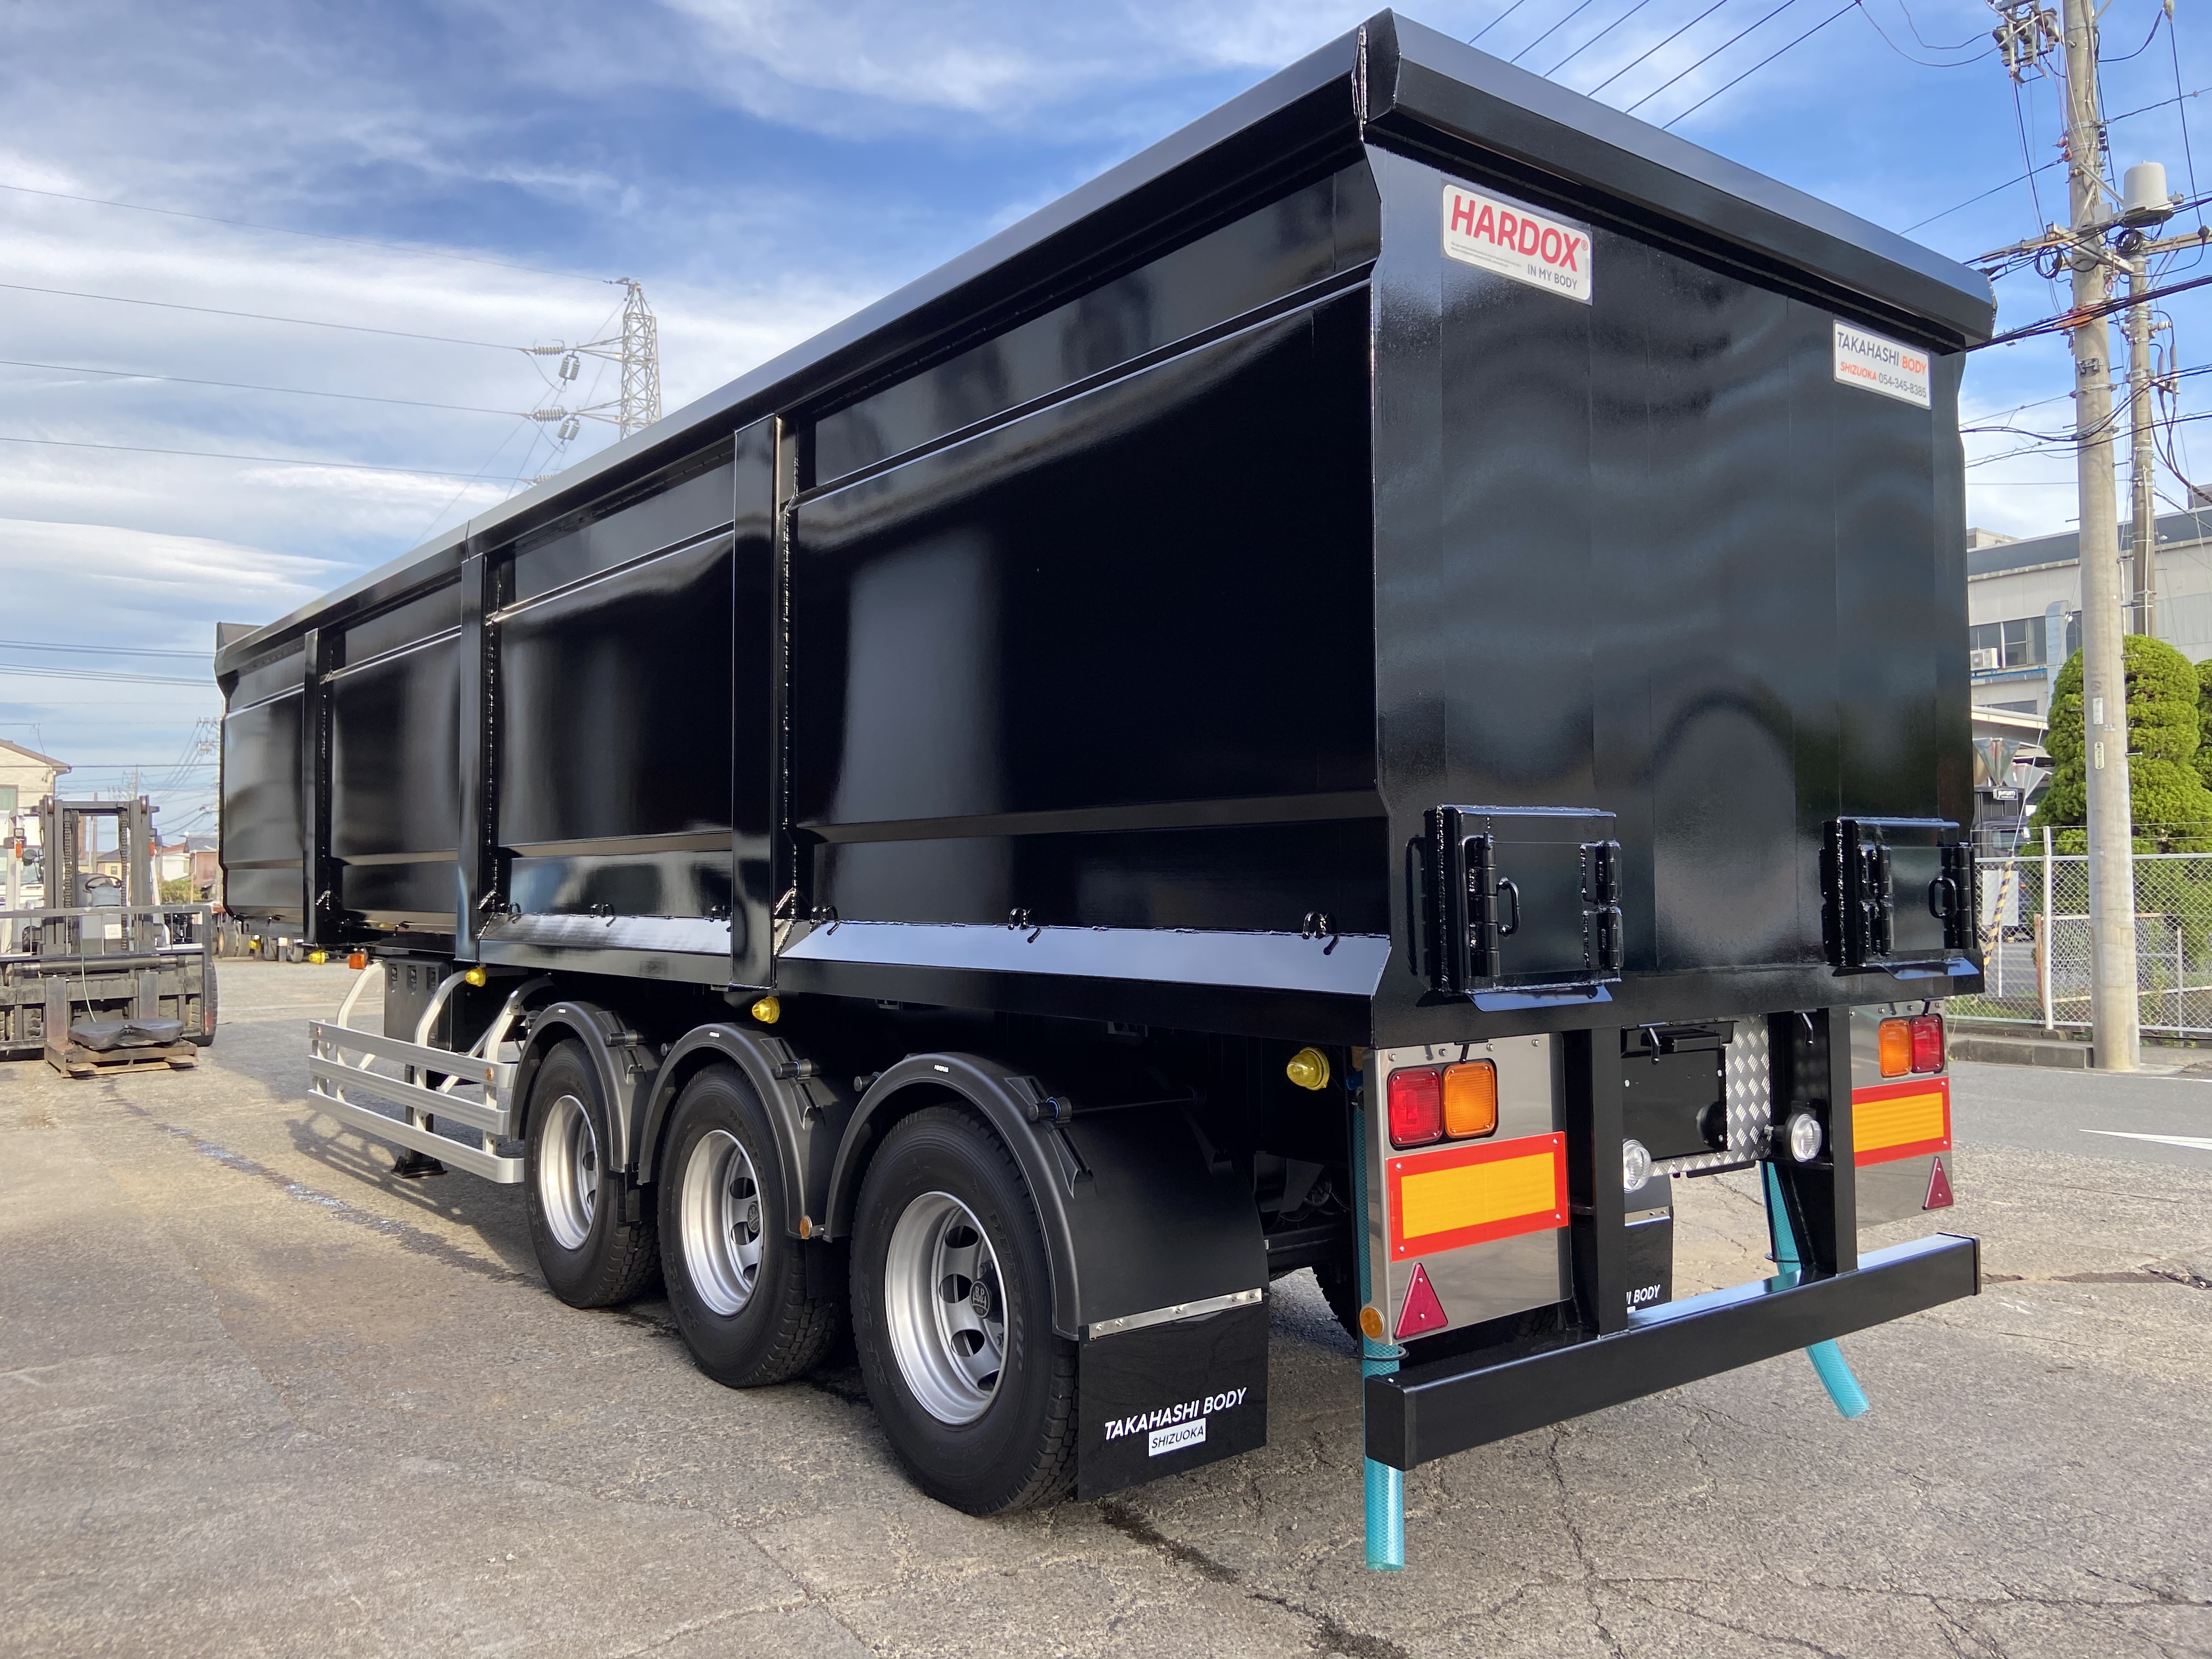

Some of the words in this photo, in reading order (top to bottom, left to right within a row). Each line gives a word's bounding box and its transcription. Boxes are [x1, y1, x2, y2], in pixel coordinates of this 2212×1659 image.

[1527, 263, 1537, 276] IN
[1539, 268, 1552, 281] MY
[1554, 272, 1577, 290] BODY
[1837, 332, 1899, 366] TAKAHASHI
[1901, 355, 1927, 375] BODY
[1840, 361, 1877, 381] SHIZUOKA
[1878, 373, 1927, 398] 054-345-8385
[1633, 1284, 1661, 1304] BODY
[1104, 1400, 1200, 1440] TAKAHASHI
[1203, 1387, 1247, 1414] BODY
[1151, 1425, 1204, 1448] SHIZUOKA
